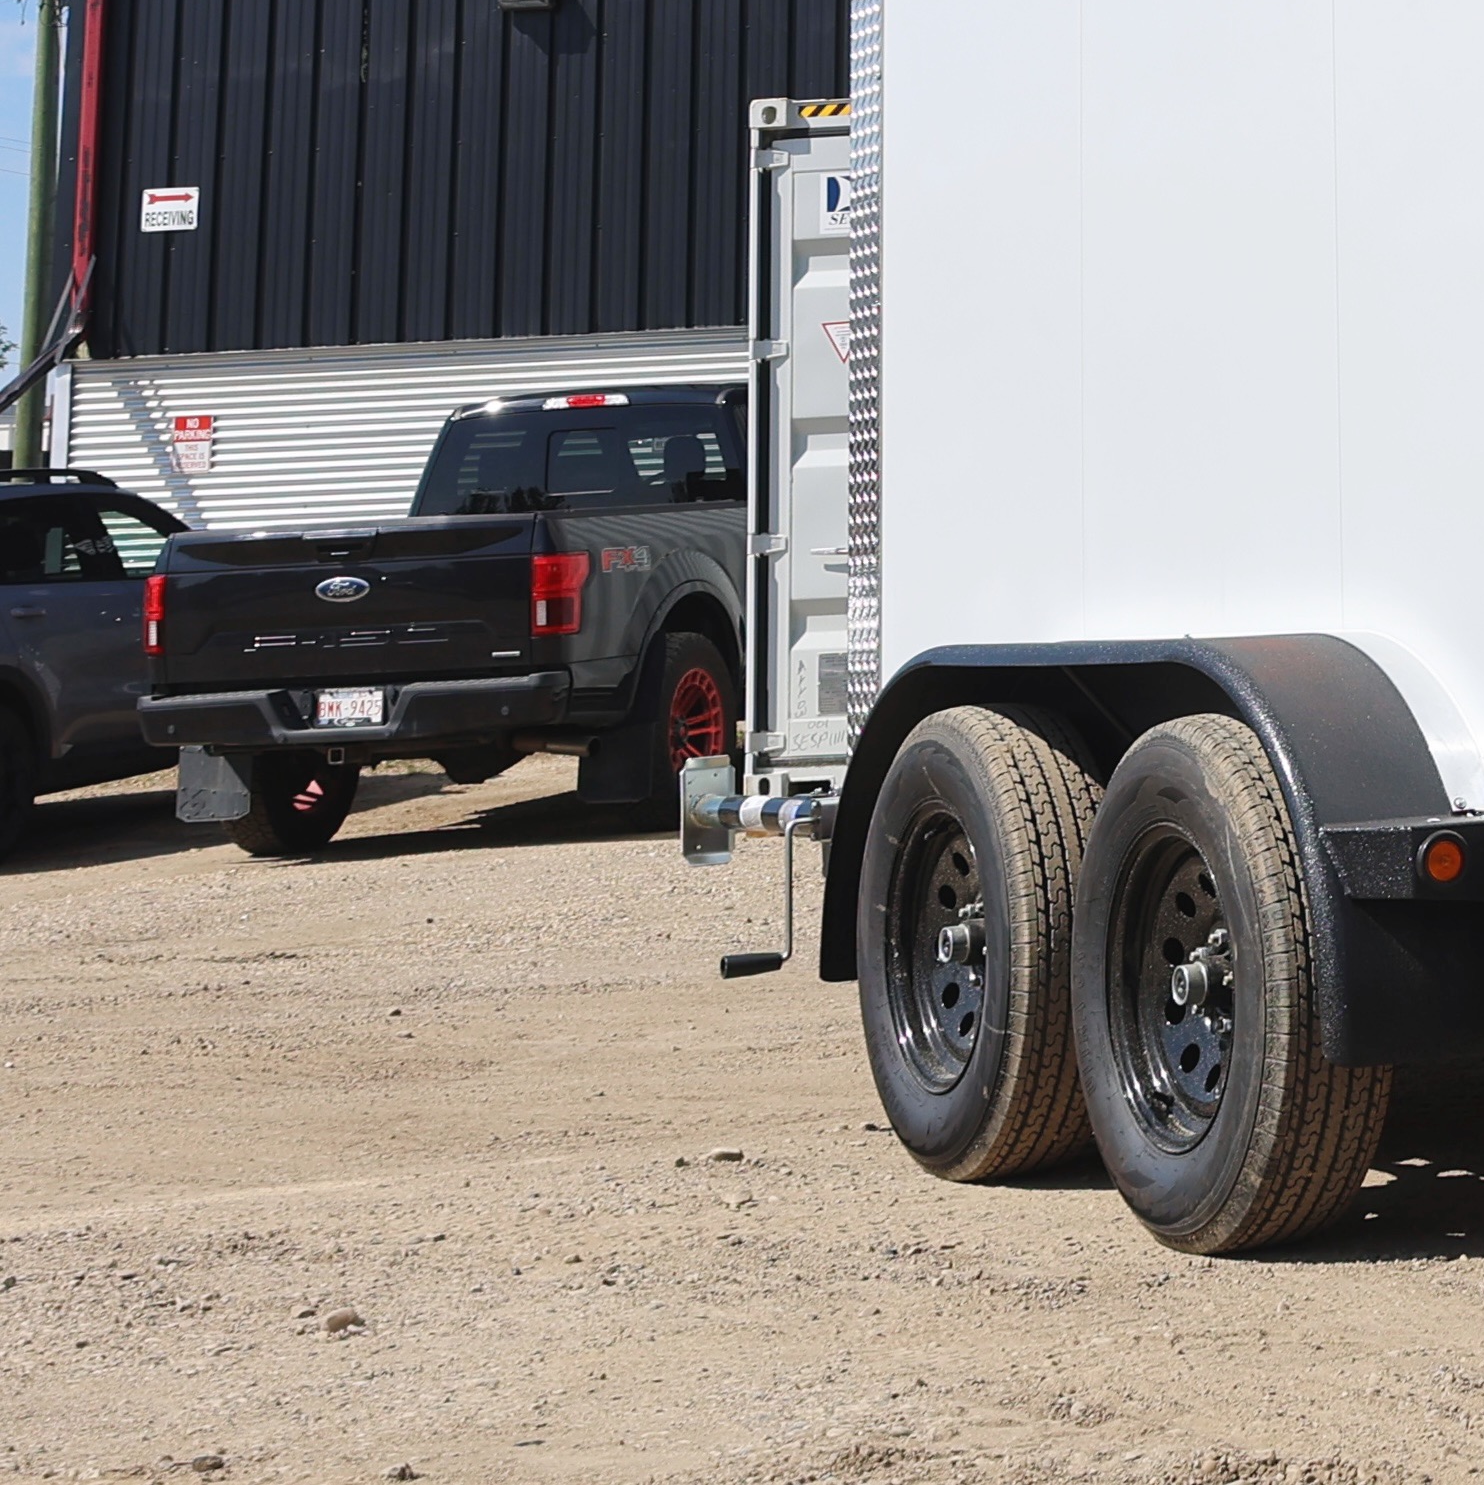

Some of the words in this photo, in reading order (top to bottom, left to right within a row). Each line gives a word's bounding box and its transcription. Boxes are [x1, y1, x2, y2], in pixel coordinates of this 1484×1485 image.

[145, 210, 194, 227] RECEIVING
[186, 418, 200, 429] NO
[174, 429, 211, 440] PARKING
[601, 546, 651, 572] FX4
[318, 699, 382, 718] BMK-9425
